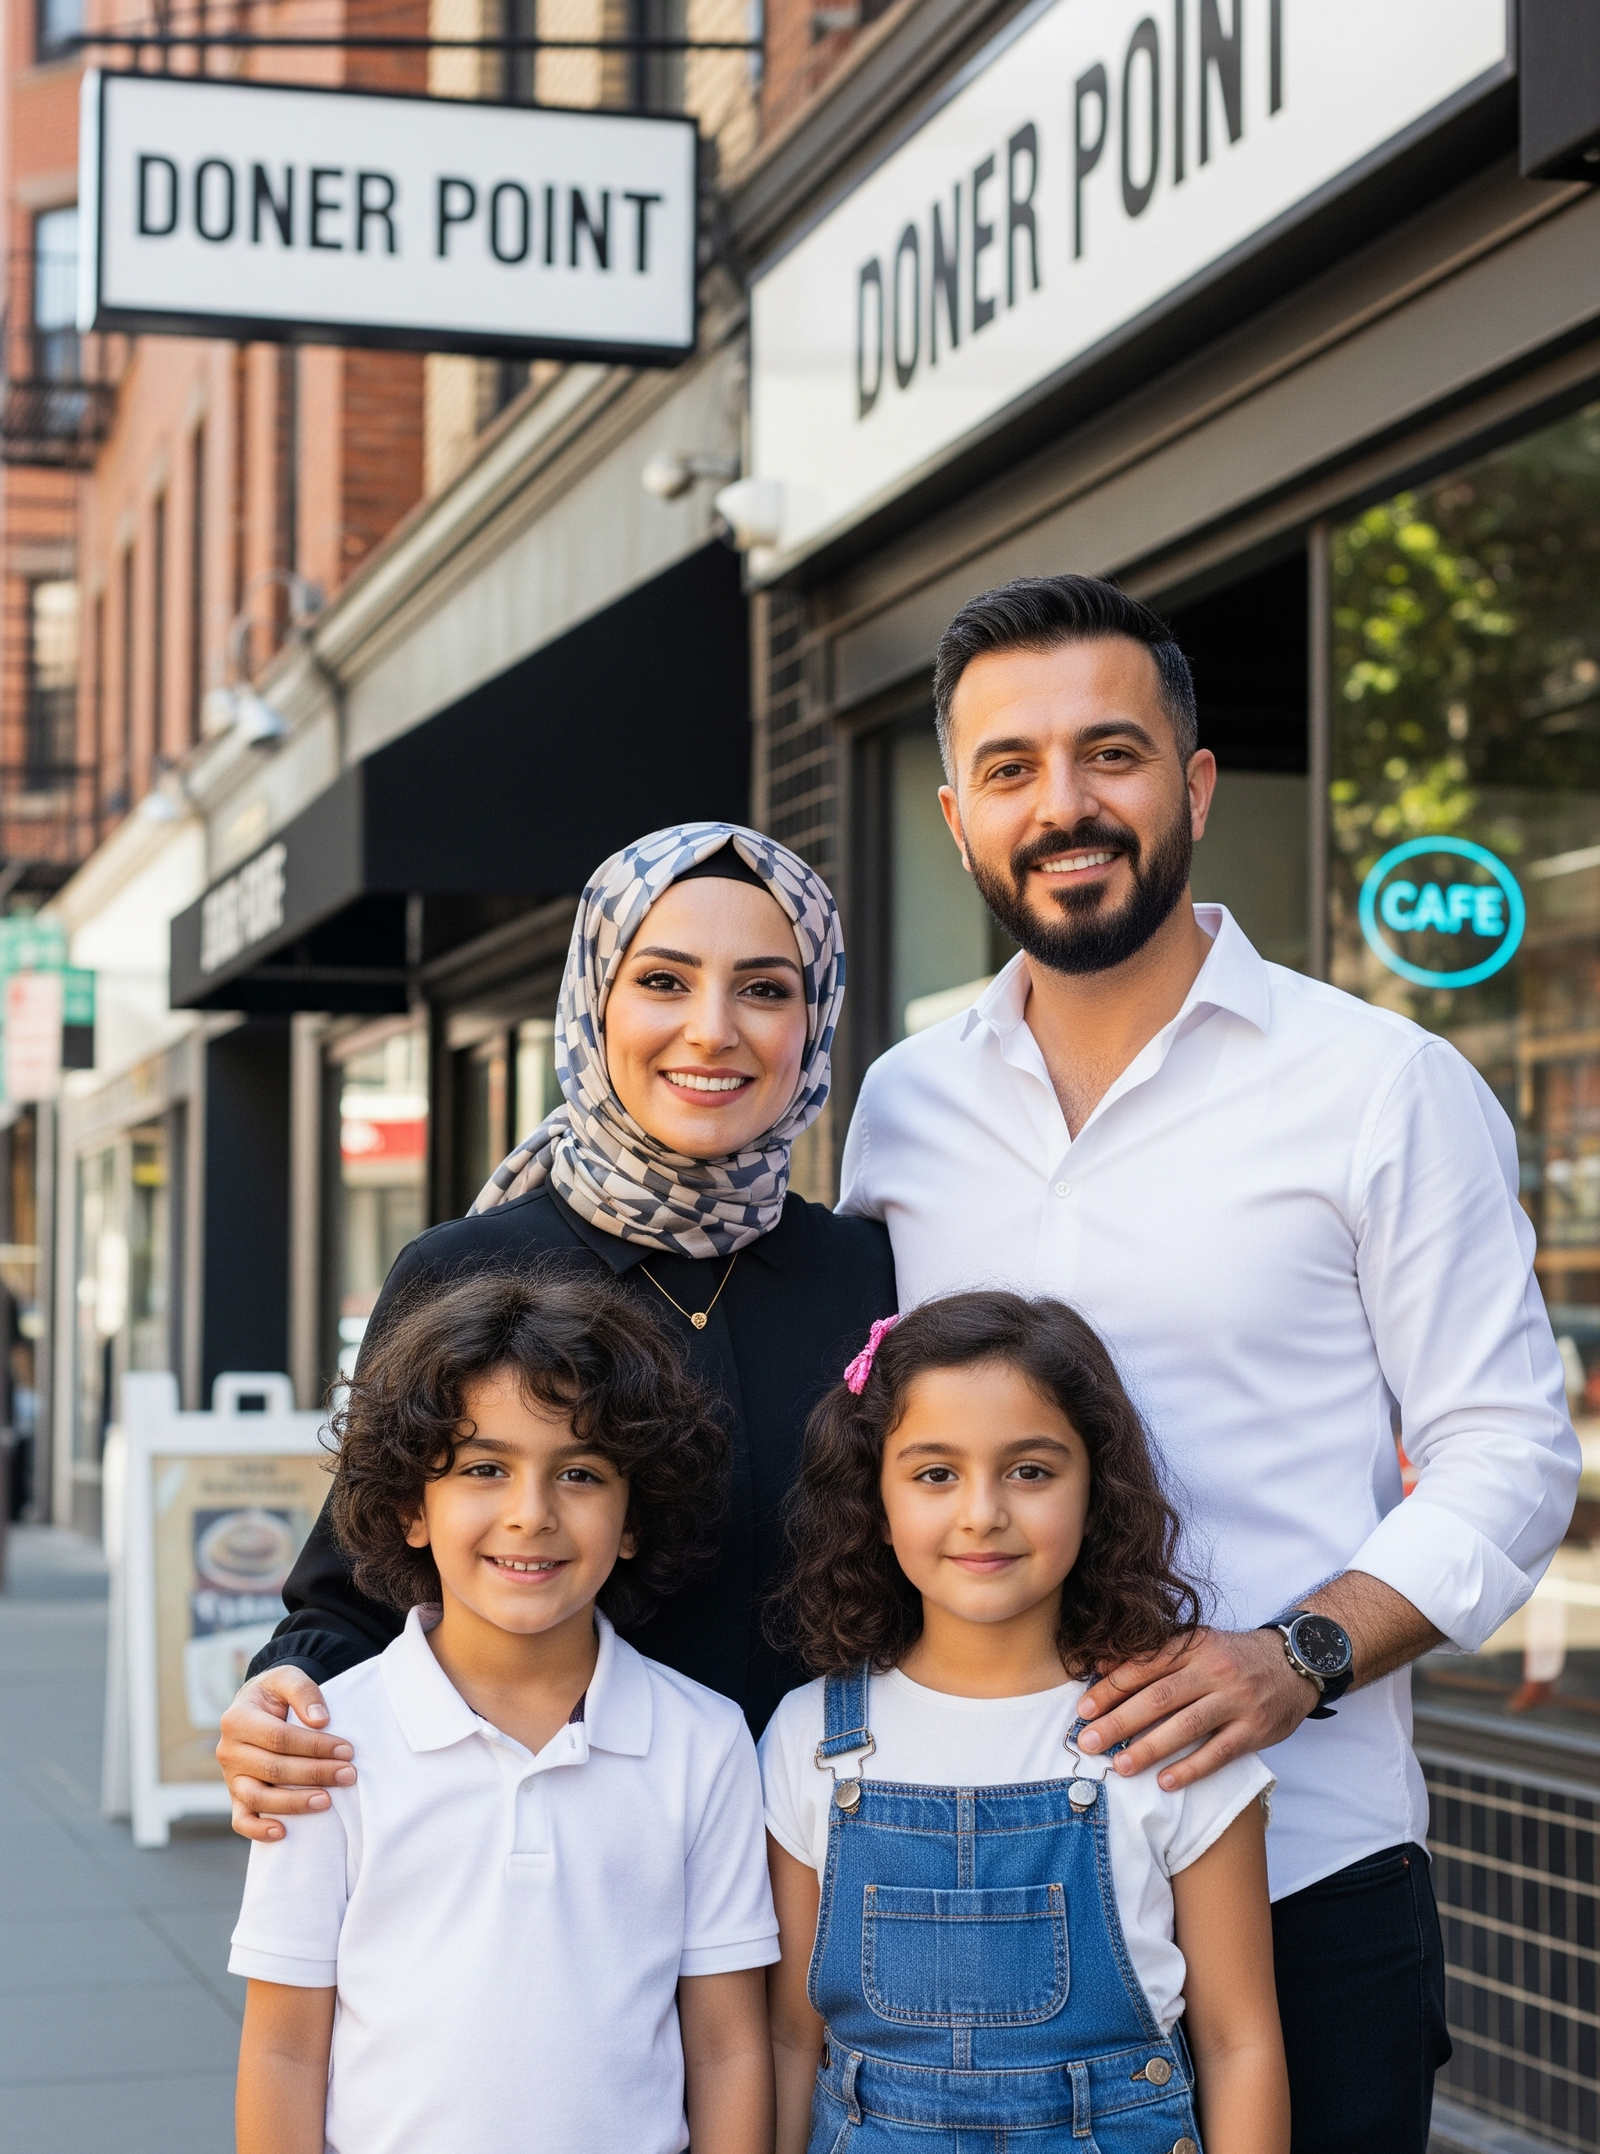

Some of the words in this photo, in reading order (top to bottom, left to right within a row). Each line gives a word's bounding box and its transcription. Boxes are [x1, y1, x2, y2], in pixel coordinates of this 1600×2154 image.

[137, 153, 397, 255] DONER
[436, 176, 663, 274] POINT
[857, 119, 1041, 422] DONER
[1380, 880, 1505, 937] CAFE
